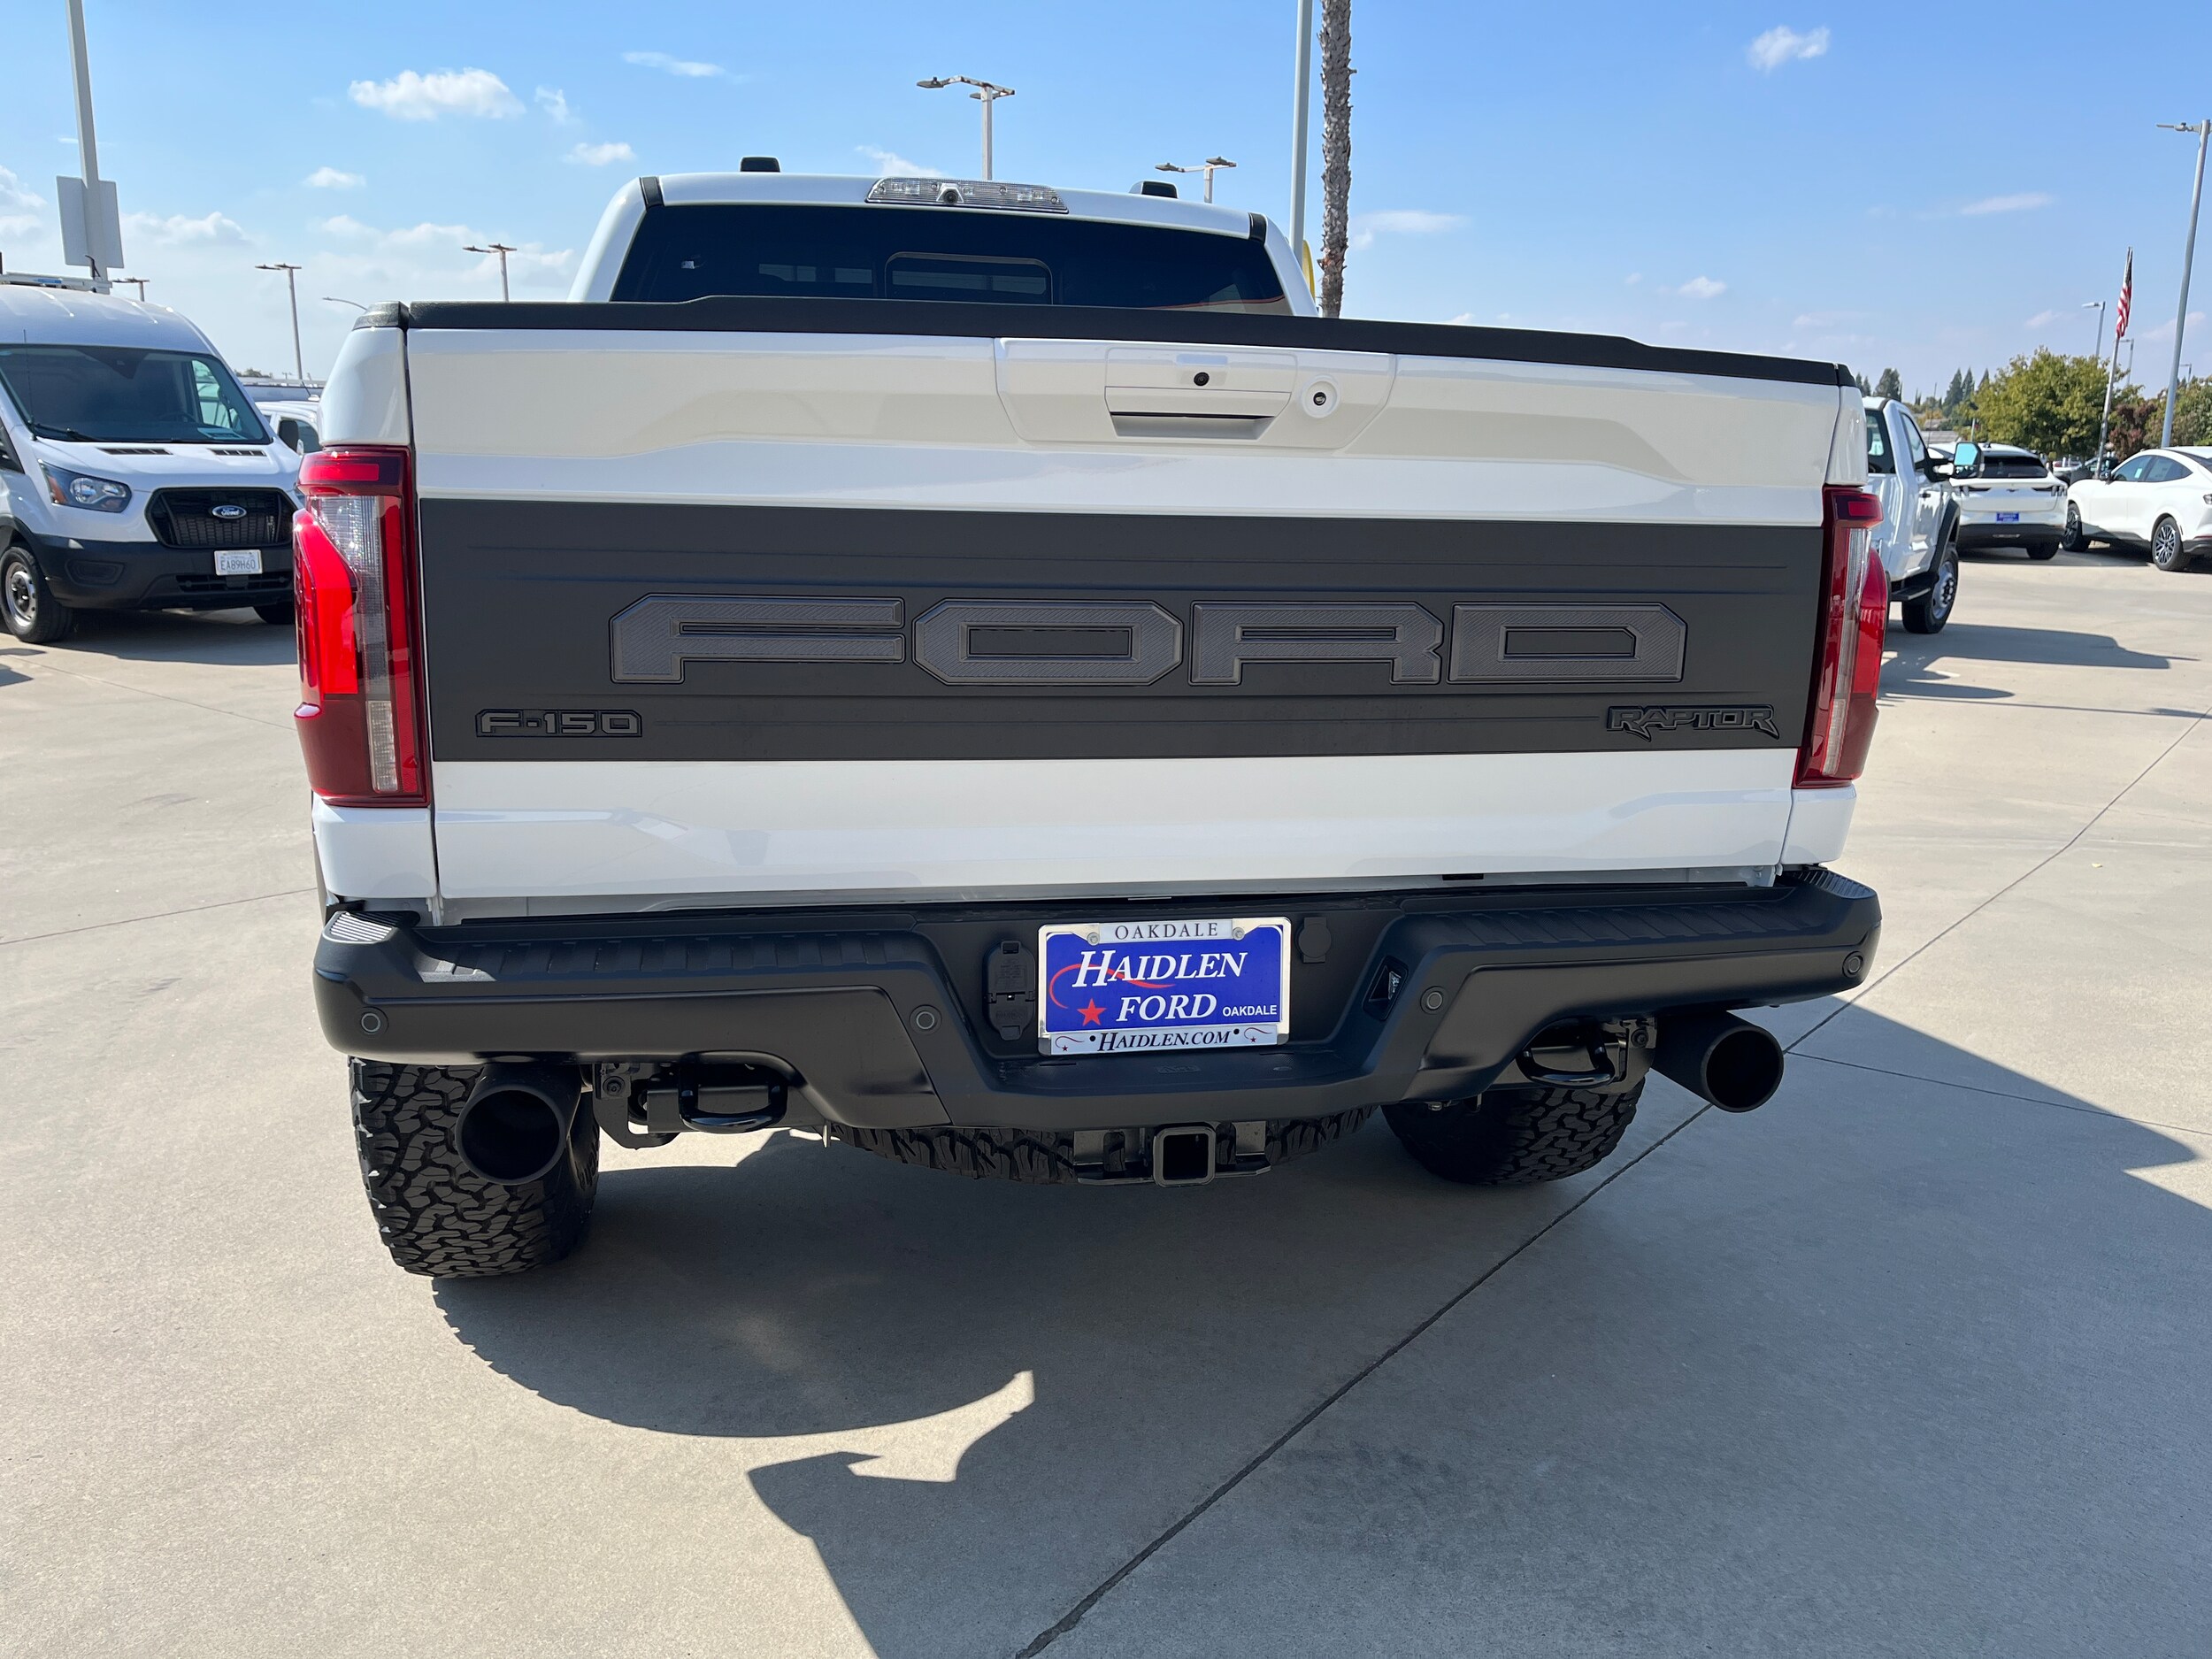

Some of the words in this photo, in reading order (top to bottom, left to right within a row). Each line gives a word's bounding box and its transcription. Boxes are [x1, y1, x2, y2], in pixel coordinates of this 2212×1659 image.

[611, 594, 1687, 687] FORD
[477, 710, 641, 736] F-150
[1608, 705, 1779, 741] RAPTOR
[1115, 922, 1218, 940] OAKDALE
[1071, 949, 1248, 987] HAIDLEN
[1116, 994, 1217, 1023] FORD
[1223, 1005, 1278, 1017] OAKDALE
[1097, 1029, 1232, 1052] HAIDLEN.COM
